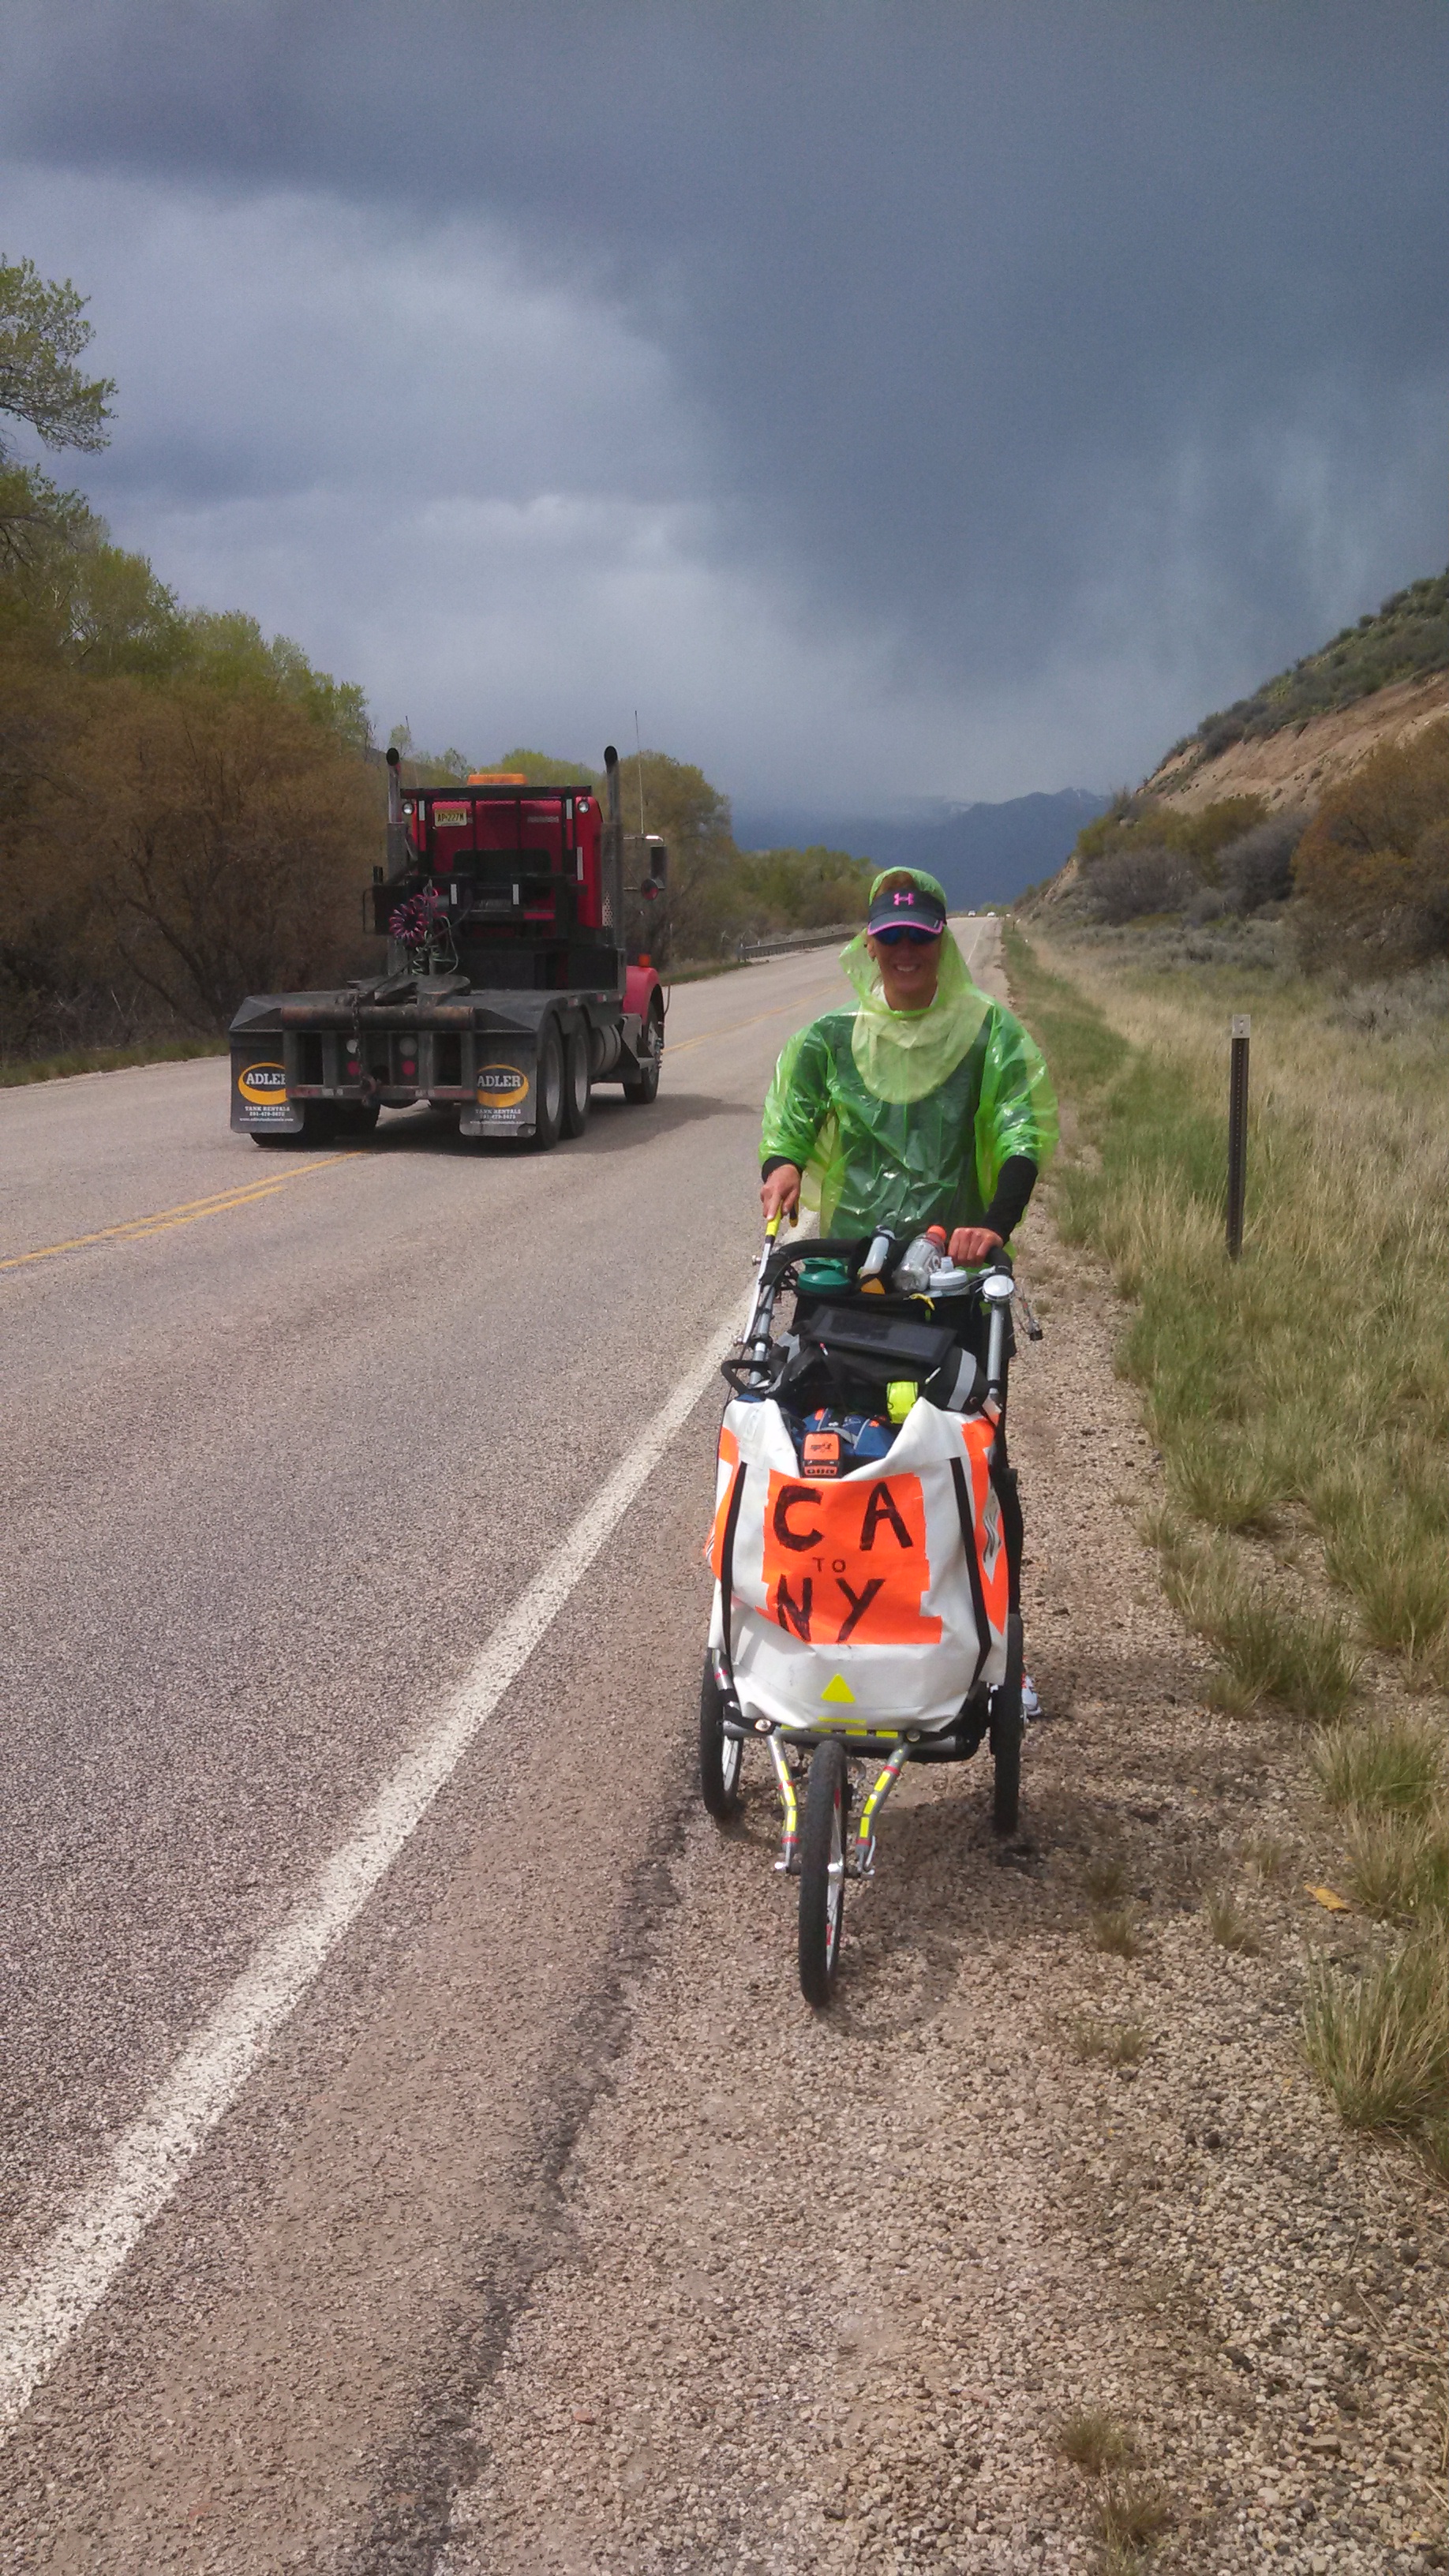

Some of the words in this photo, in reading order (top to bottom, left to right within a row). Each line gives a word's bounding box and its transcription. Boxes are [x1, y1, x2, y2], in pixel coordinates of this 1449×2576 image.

[477, 1075, 522, 1088] ADLER
[812, 1556, 846, 1573] TO
[776, 1574, 885, 1643] NY
